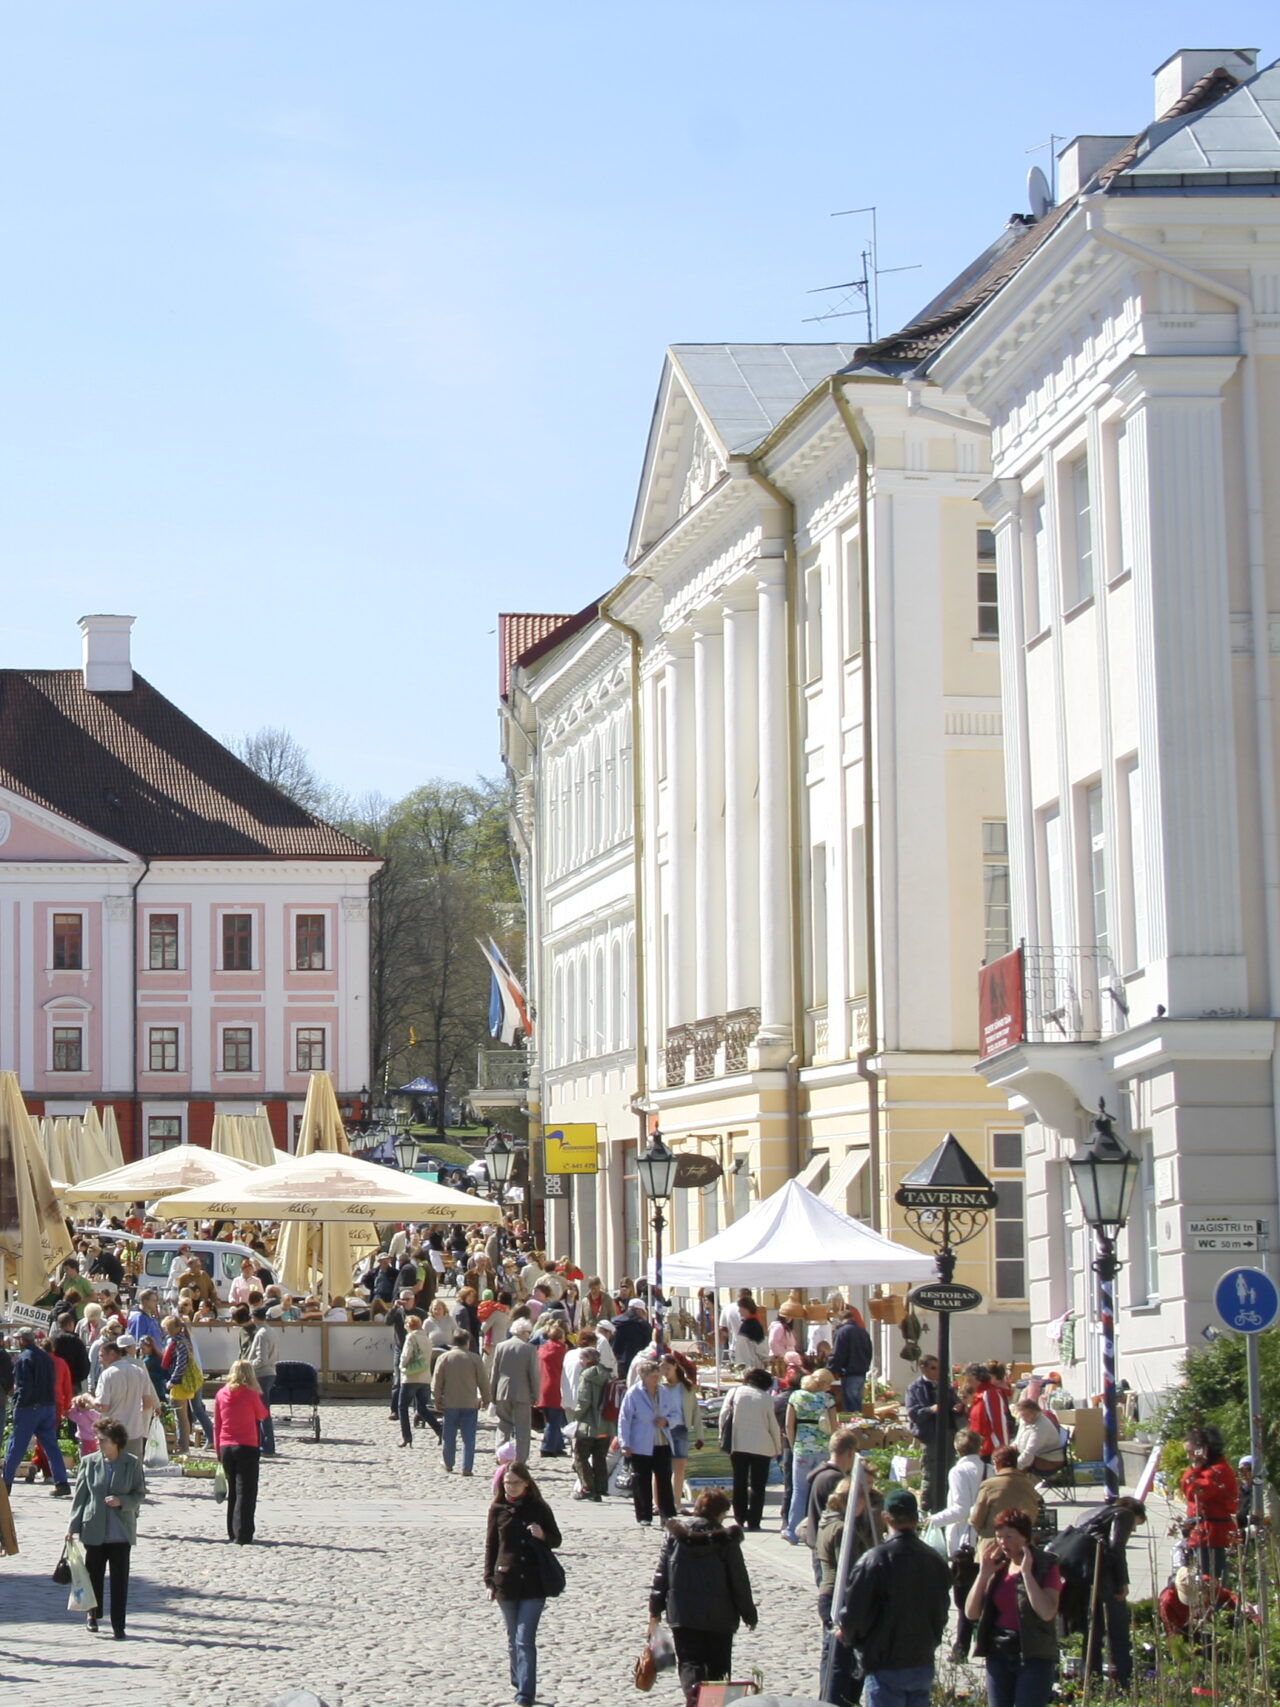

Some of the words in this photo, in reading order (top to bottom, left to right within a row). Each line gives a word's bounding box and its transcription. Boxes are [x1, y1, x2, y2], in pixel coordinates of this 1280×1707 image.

[904, 1191, 988, 1205] TAVERNA
[1190, 1223, 1241, 1232] MAGISTRI
[1243, 1223, 1253, 1232] tn
[1198, 1239, 1216, 1248] WC
[1221, 1240, 1231, 1248] 50
[920, 1290, 975, 1299] RESTORAN
[933, 1299, 961, 1307] BAAR
